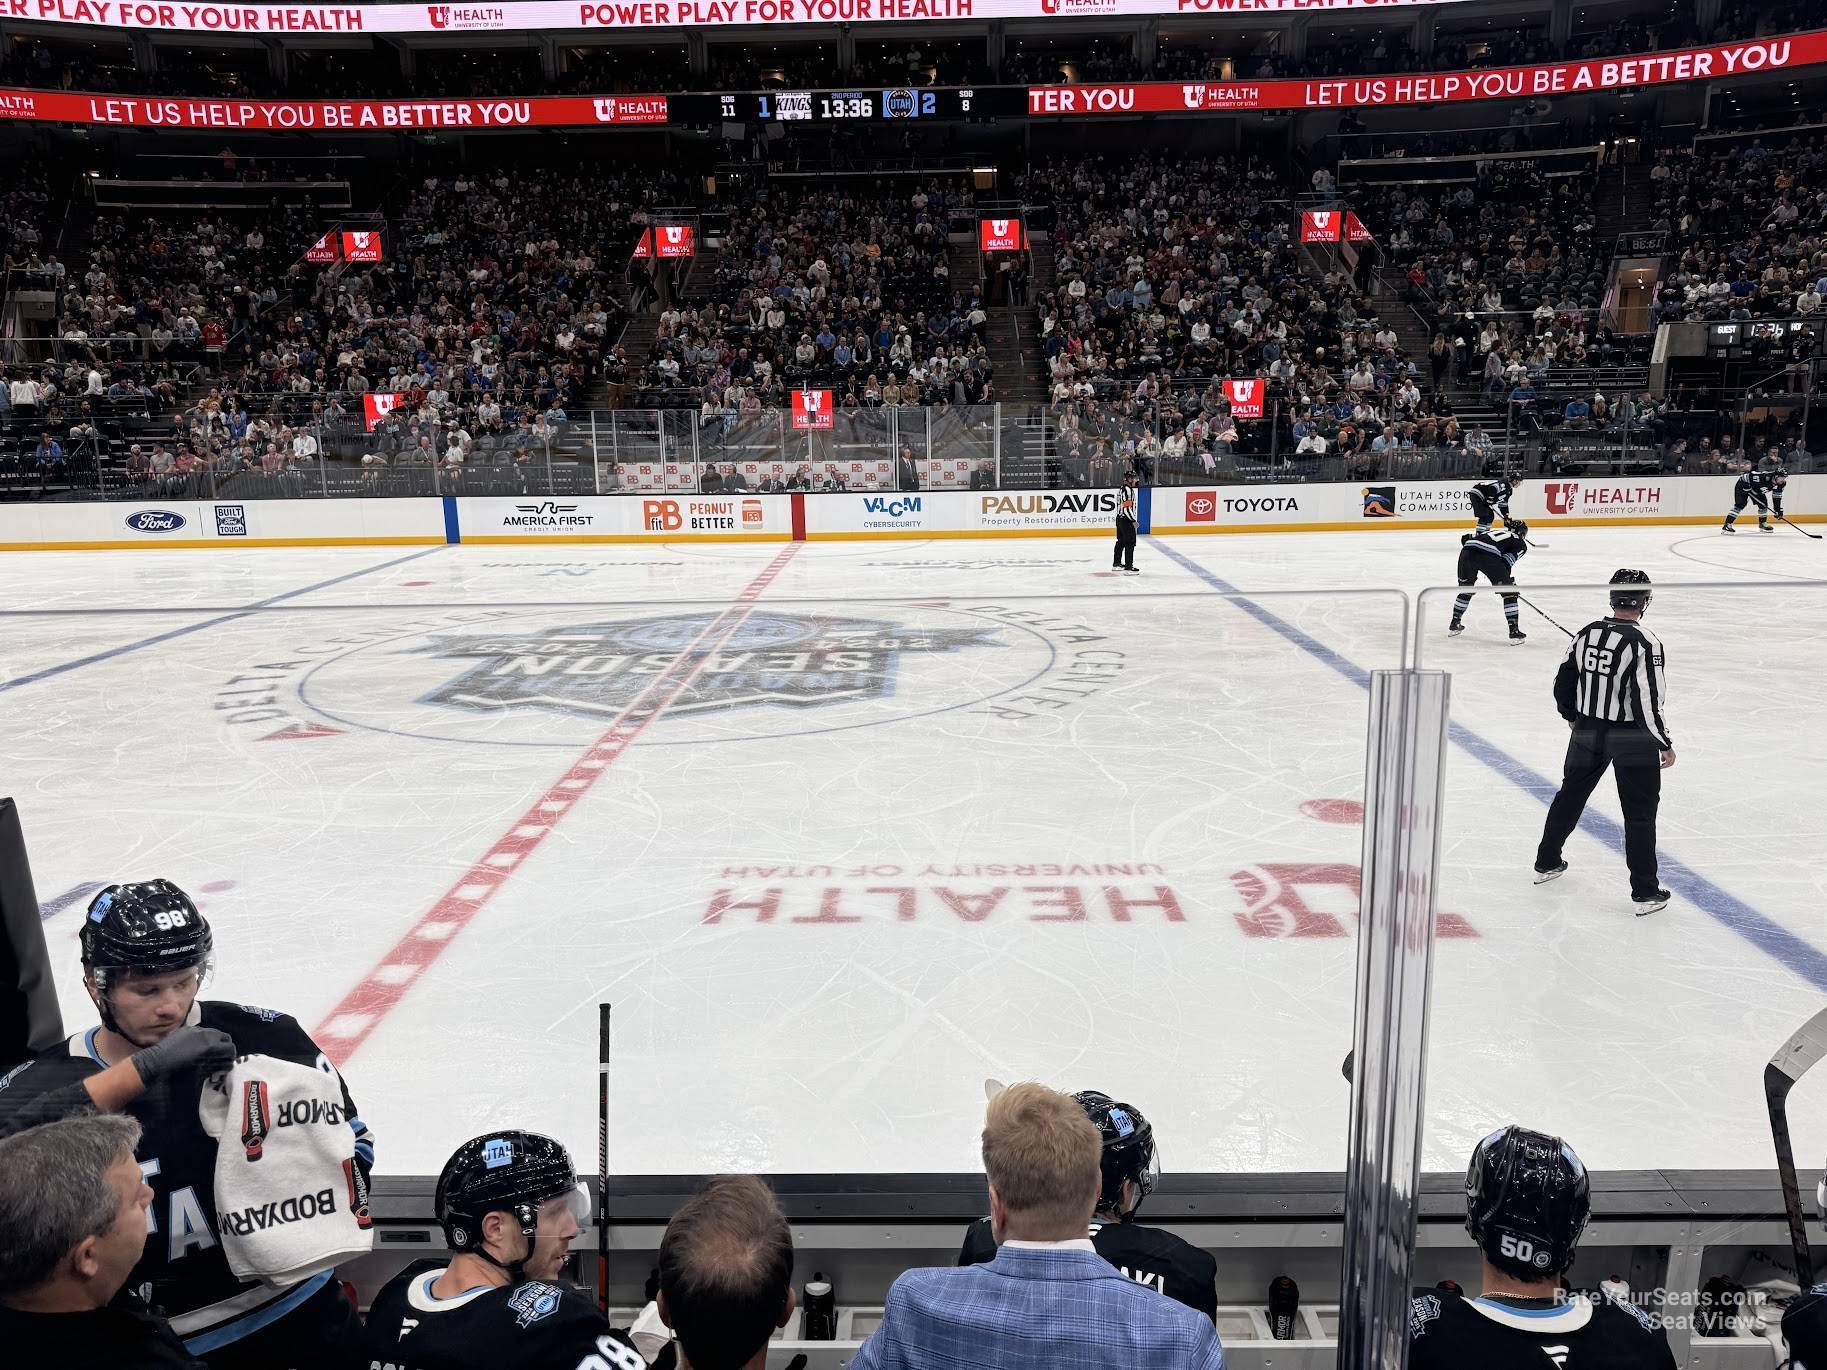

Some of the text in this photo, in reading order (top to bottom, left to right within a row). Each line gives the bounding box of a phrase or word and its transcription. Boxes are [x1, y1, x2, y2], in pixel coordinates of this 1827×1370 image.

[39, 0, 110, 22] PLAY
[120, 4, 176, 26] FOR
[181, 7, 260, 30] YOUR
[267, 10, 363, 30] HEALTH
[454, 9, 503, 20] HEALTH
[581, 0, 972, 25] POWER PLAY FOR YOUR HEALTH
[1306, 41, 1791, 105] LET US HELP YOU BE A BETTER YOU
[1029, 89, 1134, 111] TER YOU
[1208, 88, 1259, 100] HEALTH
[619, 102, 667, 113] HEALTH
[758, 97, 770, 117] 1
[776, 97, 812, 111] KINGS
[821, 99, 873, 118] 13:36
[890, 99, 911, 110] UTAH
[922, 92, 936, 114] 2
[962, 100, 970, 111] 8
[91, 100, 530, 126] LET US HELP YOU BE A BETTER YOU
[722, 105, 736, 117] 11
[1717, 326, 1737, 334] GUEST
[1231, 405, 1259, 413] EALTH
[797, 415, 829, 423] HETH
[1400, 491, 1471, 500] UTAH SPOR
[1544, 483, 1579, 515] U
[1584, 488, 1661, 504] HEALTH
[217, 508, 241, 517] BUILT
[690, 503, 734, 514] PEANUT
[1224, 498, 1299, 513] TOYOTA
[1400, 502, 1472, 511] COMMISSIO
[137, 513, 174, 529] Ford
[503, 516, 594, 525] AMERICA FIRST
[643, 500, 683, 530] PB
[982, 515, 1116, 525] Property Restoration Experts
[220, 526, 244, 534] TOUGH
[651, 517, 664, 531] fit
[691, 517, 734, 529] BETTER
[964, 605, 1108, 643] DELTA
[493, 651, 873, 676] SEASON
[1585, 647, 1613, 675] 62
[1653, 656, 1662, 666] 62
[213, 659, 314, 725] DELTA
[968, 650, 1126, 720] CENTER
[721, 864, 1164, 879] UNIVERSITY OF UTAH
[700, 885, 1187, 925] HEALTH
[154, 910, 186, 931] 98
[160, 944, 196, 956] BAUER
[250, 1084, 262, 1136] BODYARMOR
[218, 1187, 337, 1237] BODYARM
[1500, 1234, 1534, 1263] 50
